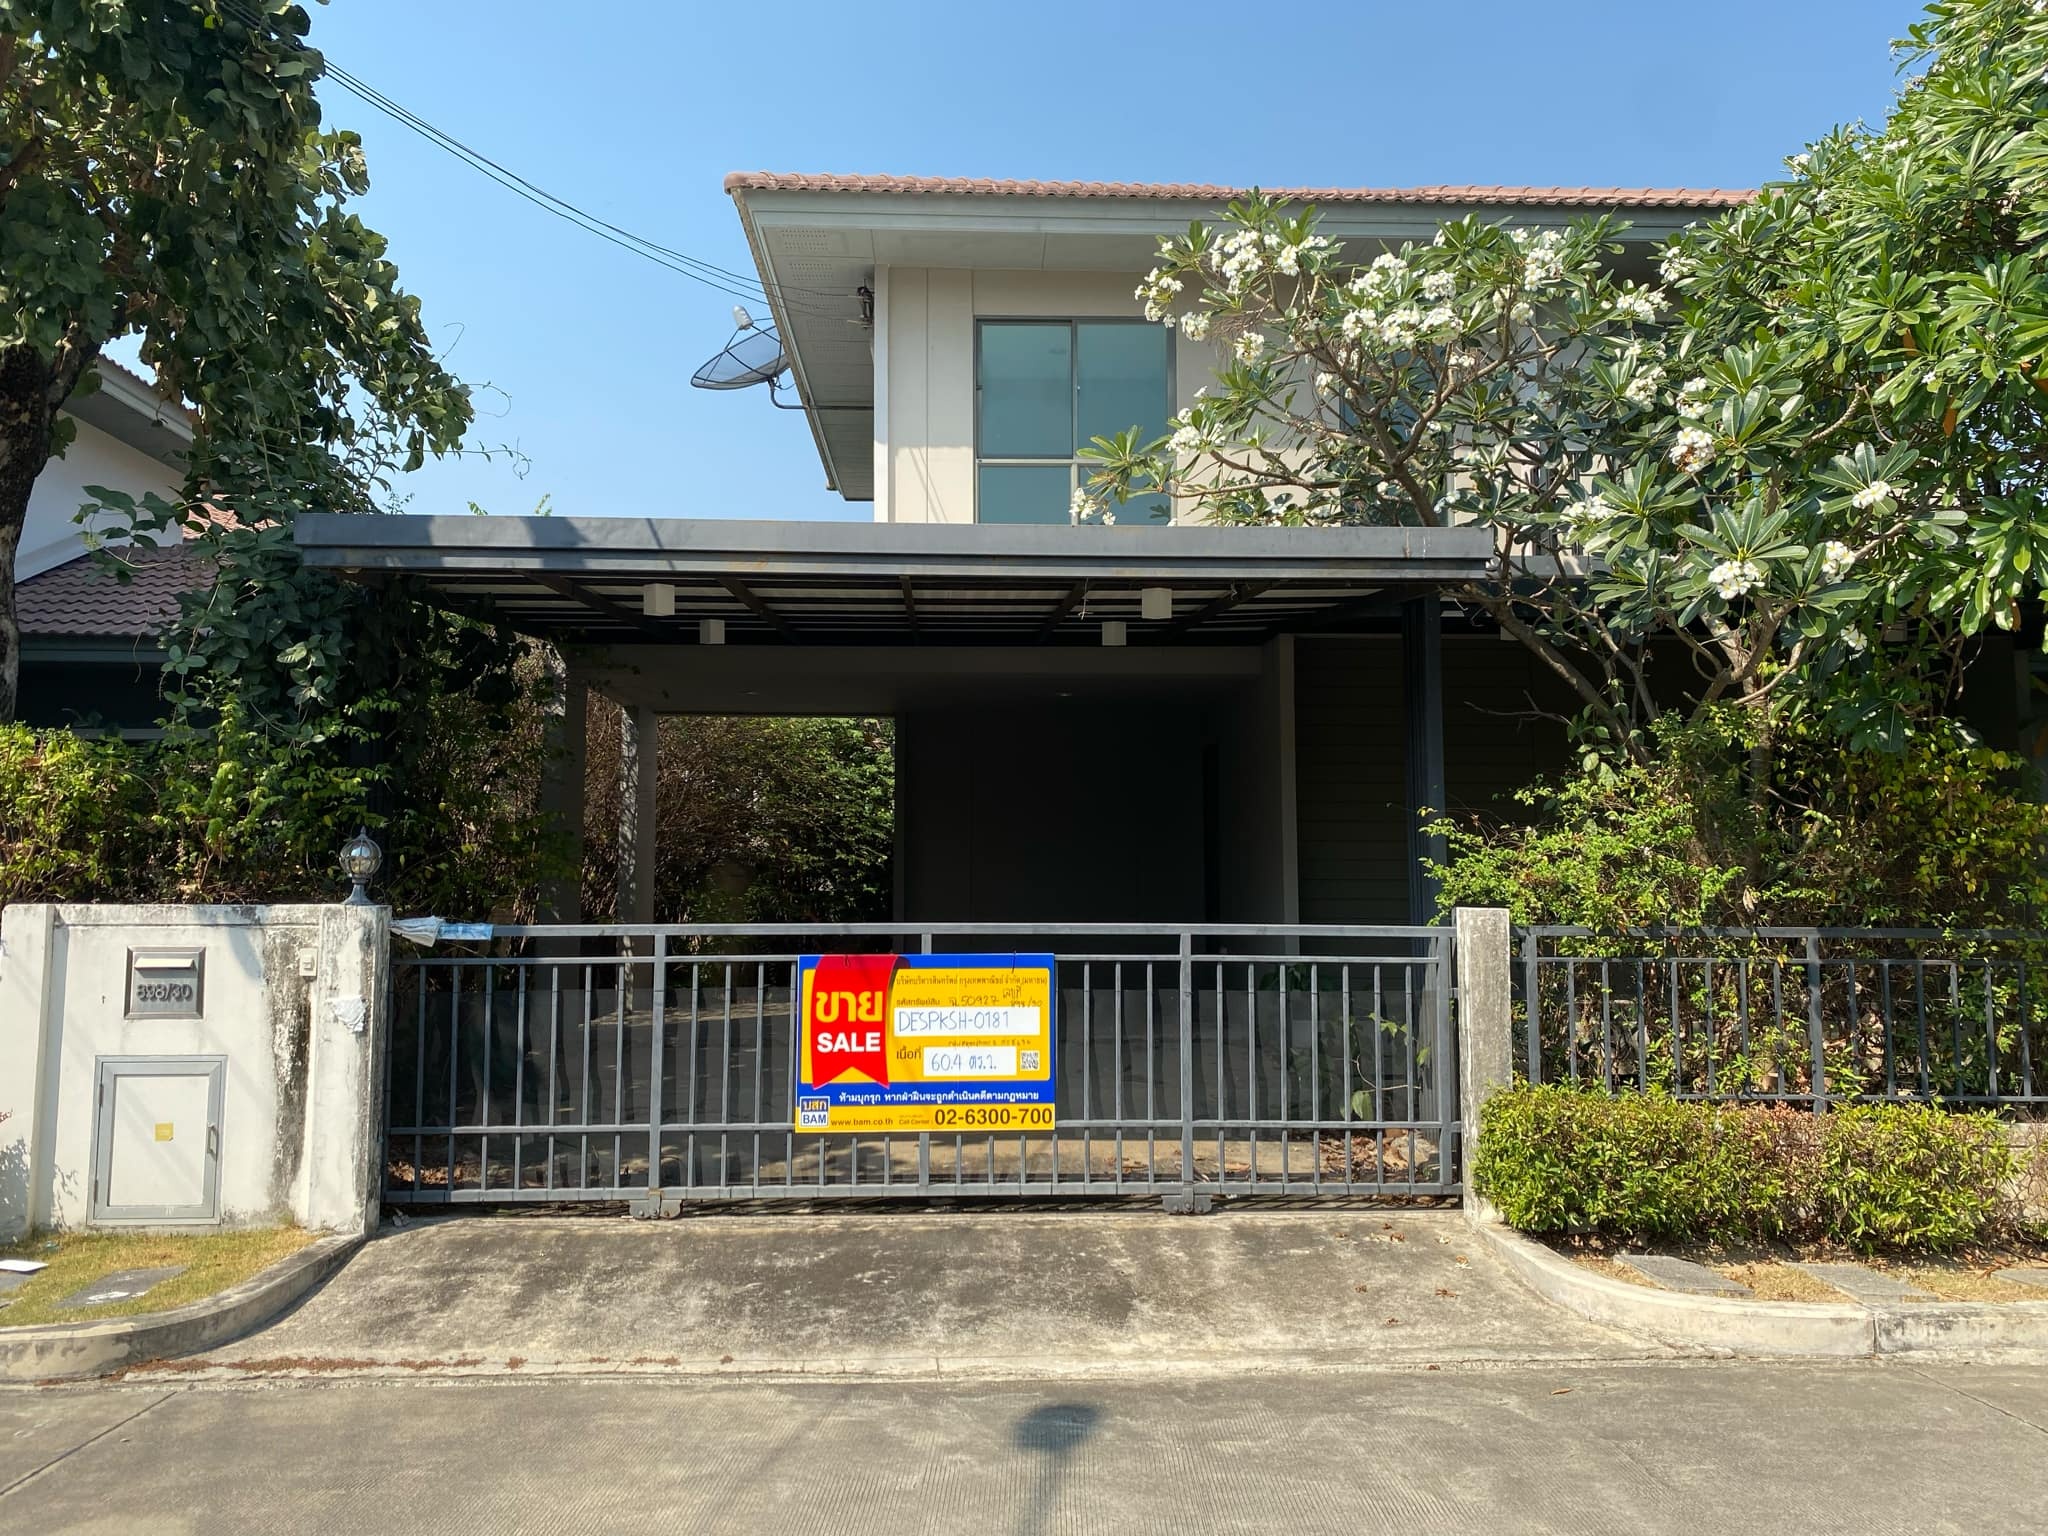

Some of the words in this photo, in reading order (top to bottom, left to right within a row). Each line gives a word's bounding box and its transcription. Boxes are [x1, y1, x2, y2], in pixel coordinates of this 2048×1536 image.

[815, 990, 883, 1023] ขาย
[898, 1011, 1009, 1032] DESPKSH-0181
[816, 1032, 881, 1053] SALE
[896, 1048, 922, 1060] เนื้อที่
[930, 1053, 962, 1072] 60.4
[838, 1091, 882, 1104] ห้ามบุกรุก
[802, 1113, 827, 1125] BAM
[830, 1117, 894, 1127] www.bam.co.th
[934, 1107, 1053, 1126] 02-6300-700
